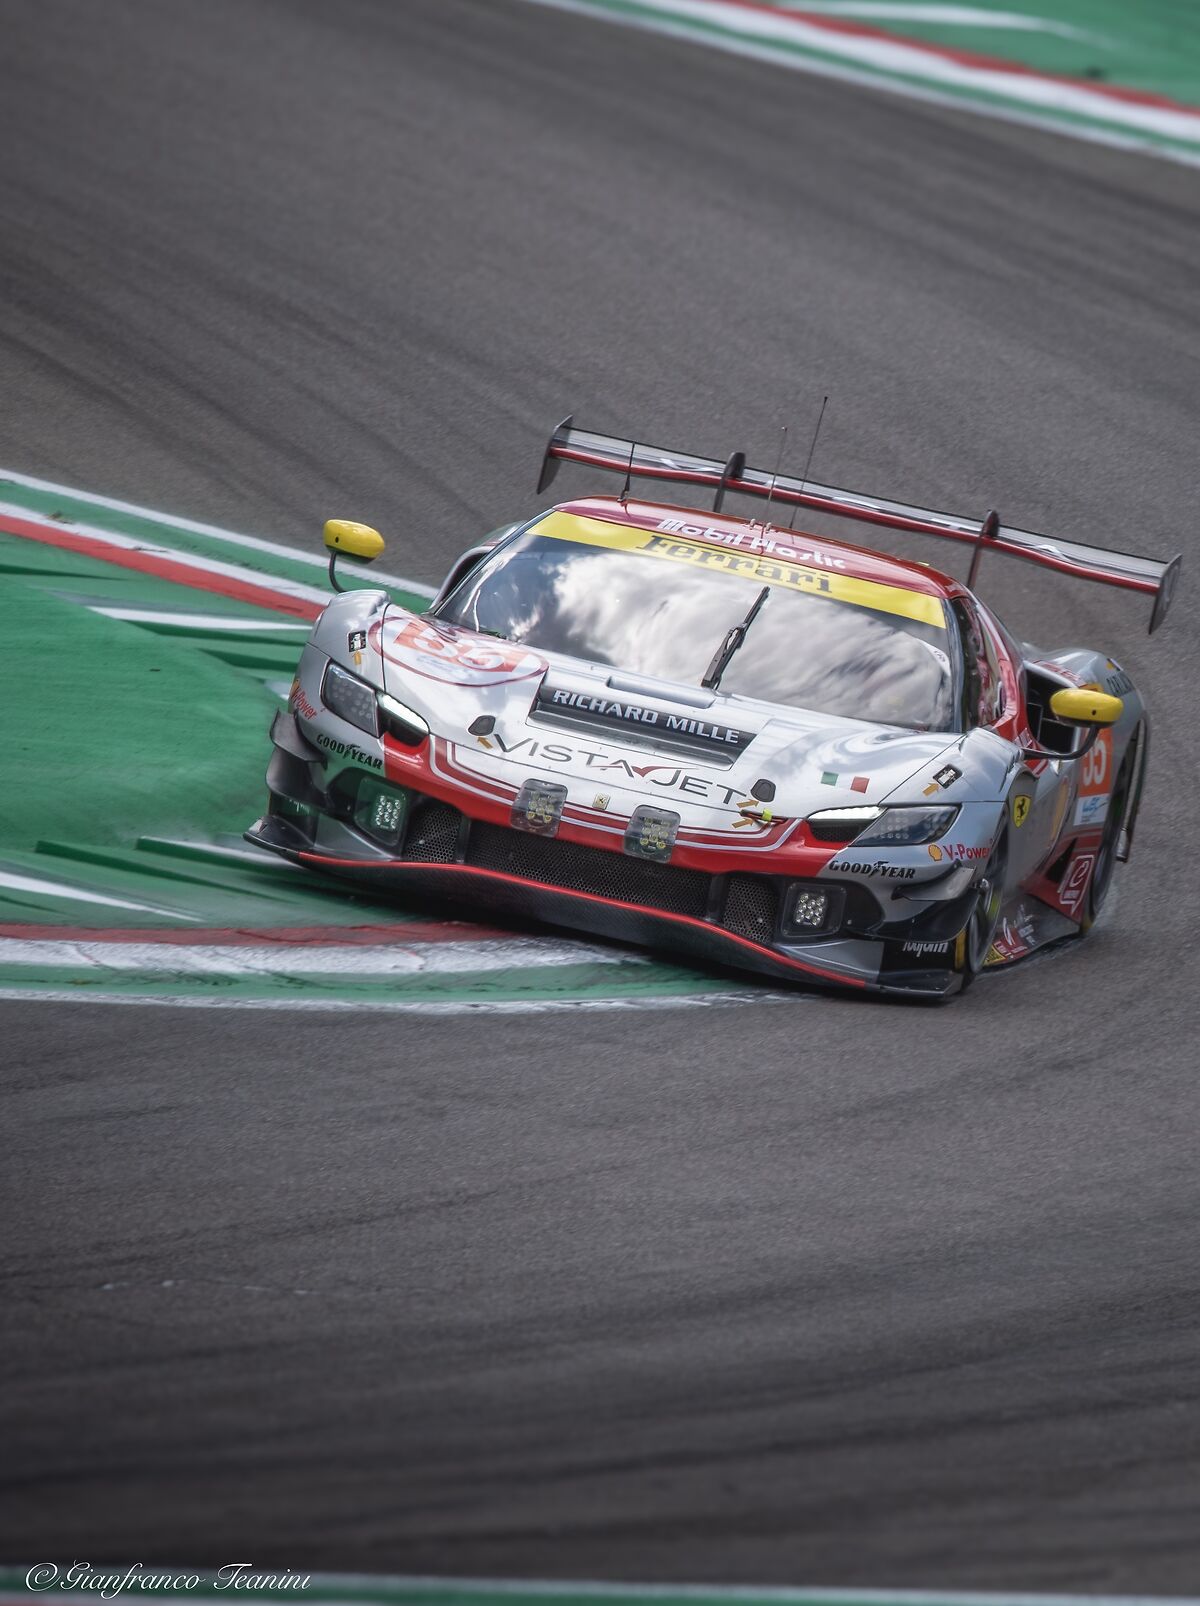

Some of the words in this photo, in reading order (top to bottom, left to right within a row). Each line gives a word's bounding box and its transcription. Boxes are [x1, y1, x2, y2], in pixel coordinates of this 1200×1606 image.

[638, 534, 832, 593] Ferrari
[656, 518, 746, 546] Mobil
[750, 536, 847, 569] Plastic
[553, 689, 660, 725] RICHARD
[666, 714, 740, 744] MILLE
[316, 733, 383, 770] GOODYEAR
[829, 860, 916, 880] GOODYEAR
